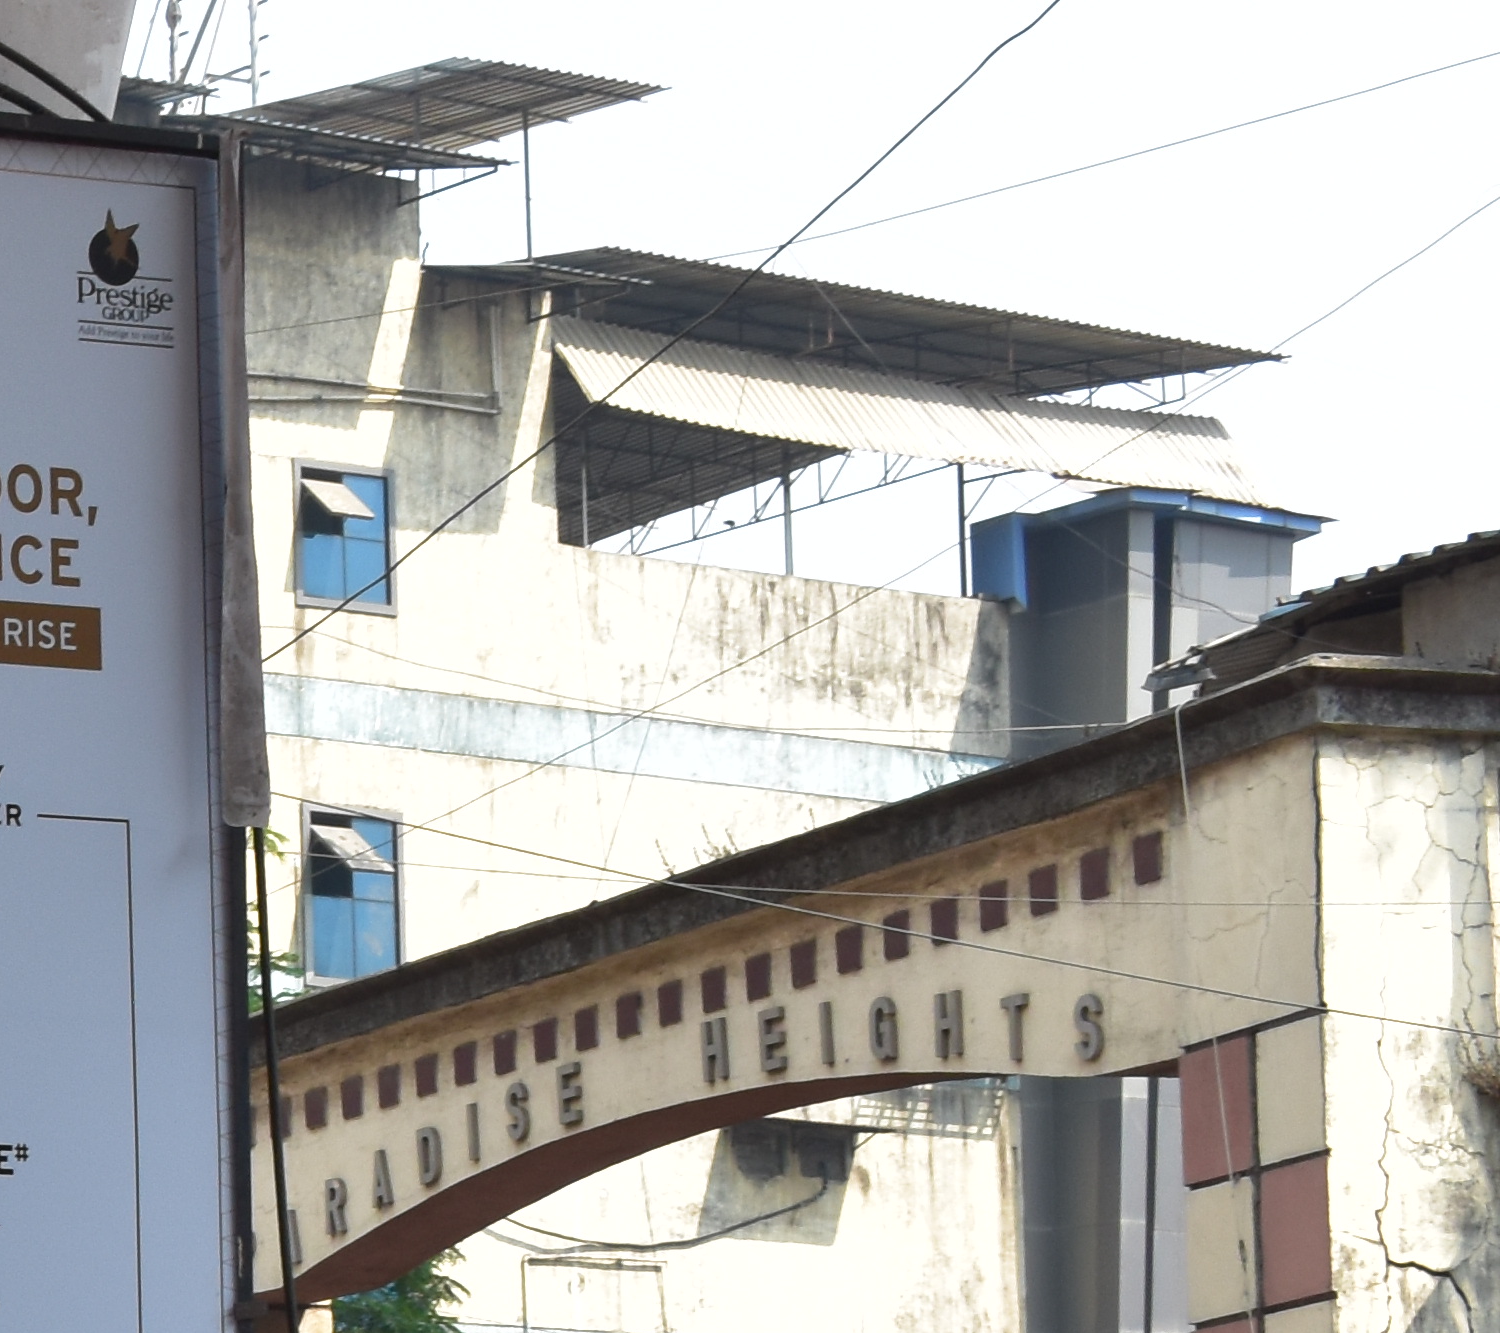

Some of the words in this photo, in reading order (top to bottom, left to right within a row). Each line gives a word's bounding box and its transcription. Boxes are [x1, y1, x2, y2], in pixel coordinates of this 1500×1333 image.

[78, 275, 173, 315] Prestige
[103, 306, 147, 323] GROUP
[4, 618, 76, 650] RISE
[700, 990, 1105, 1083] HEIGHTS
